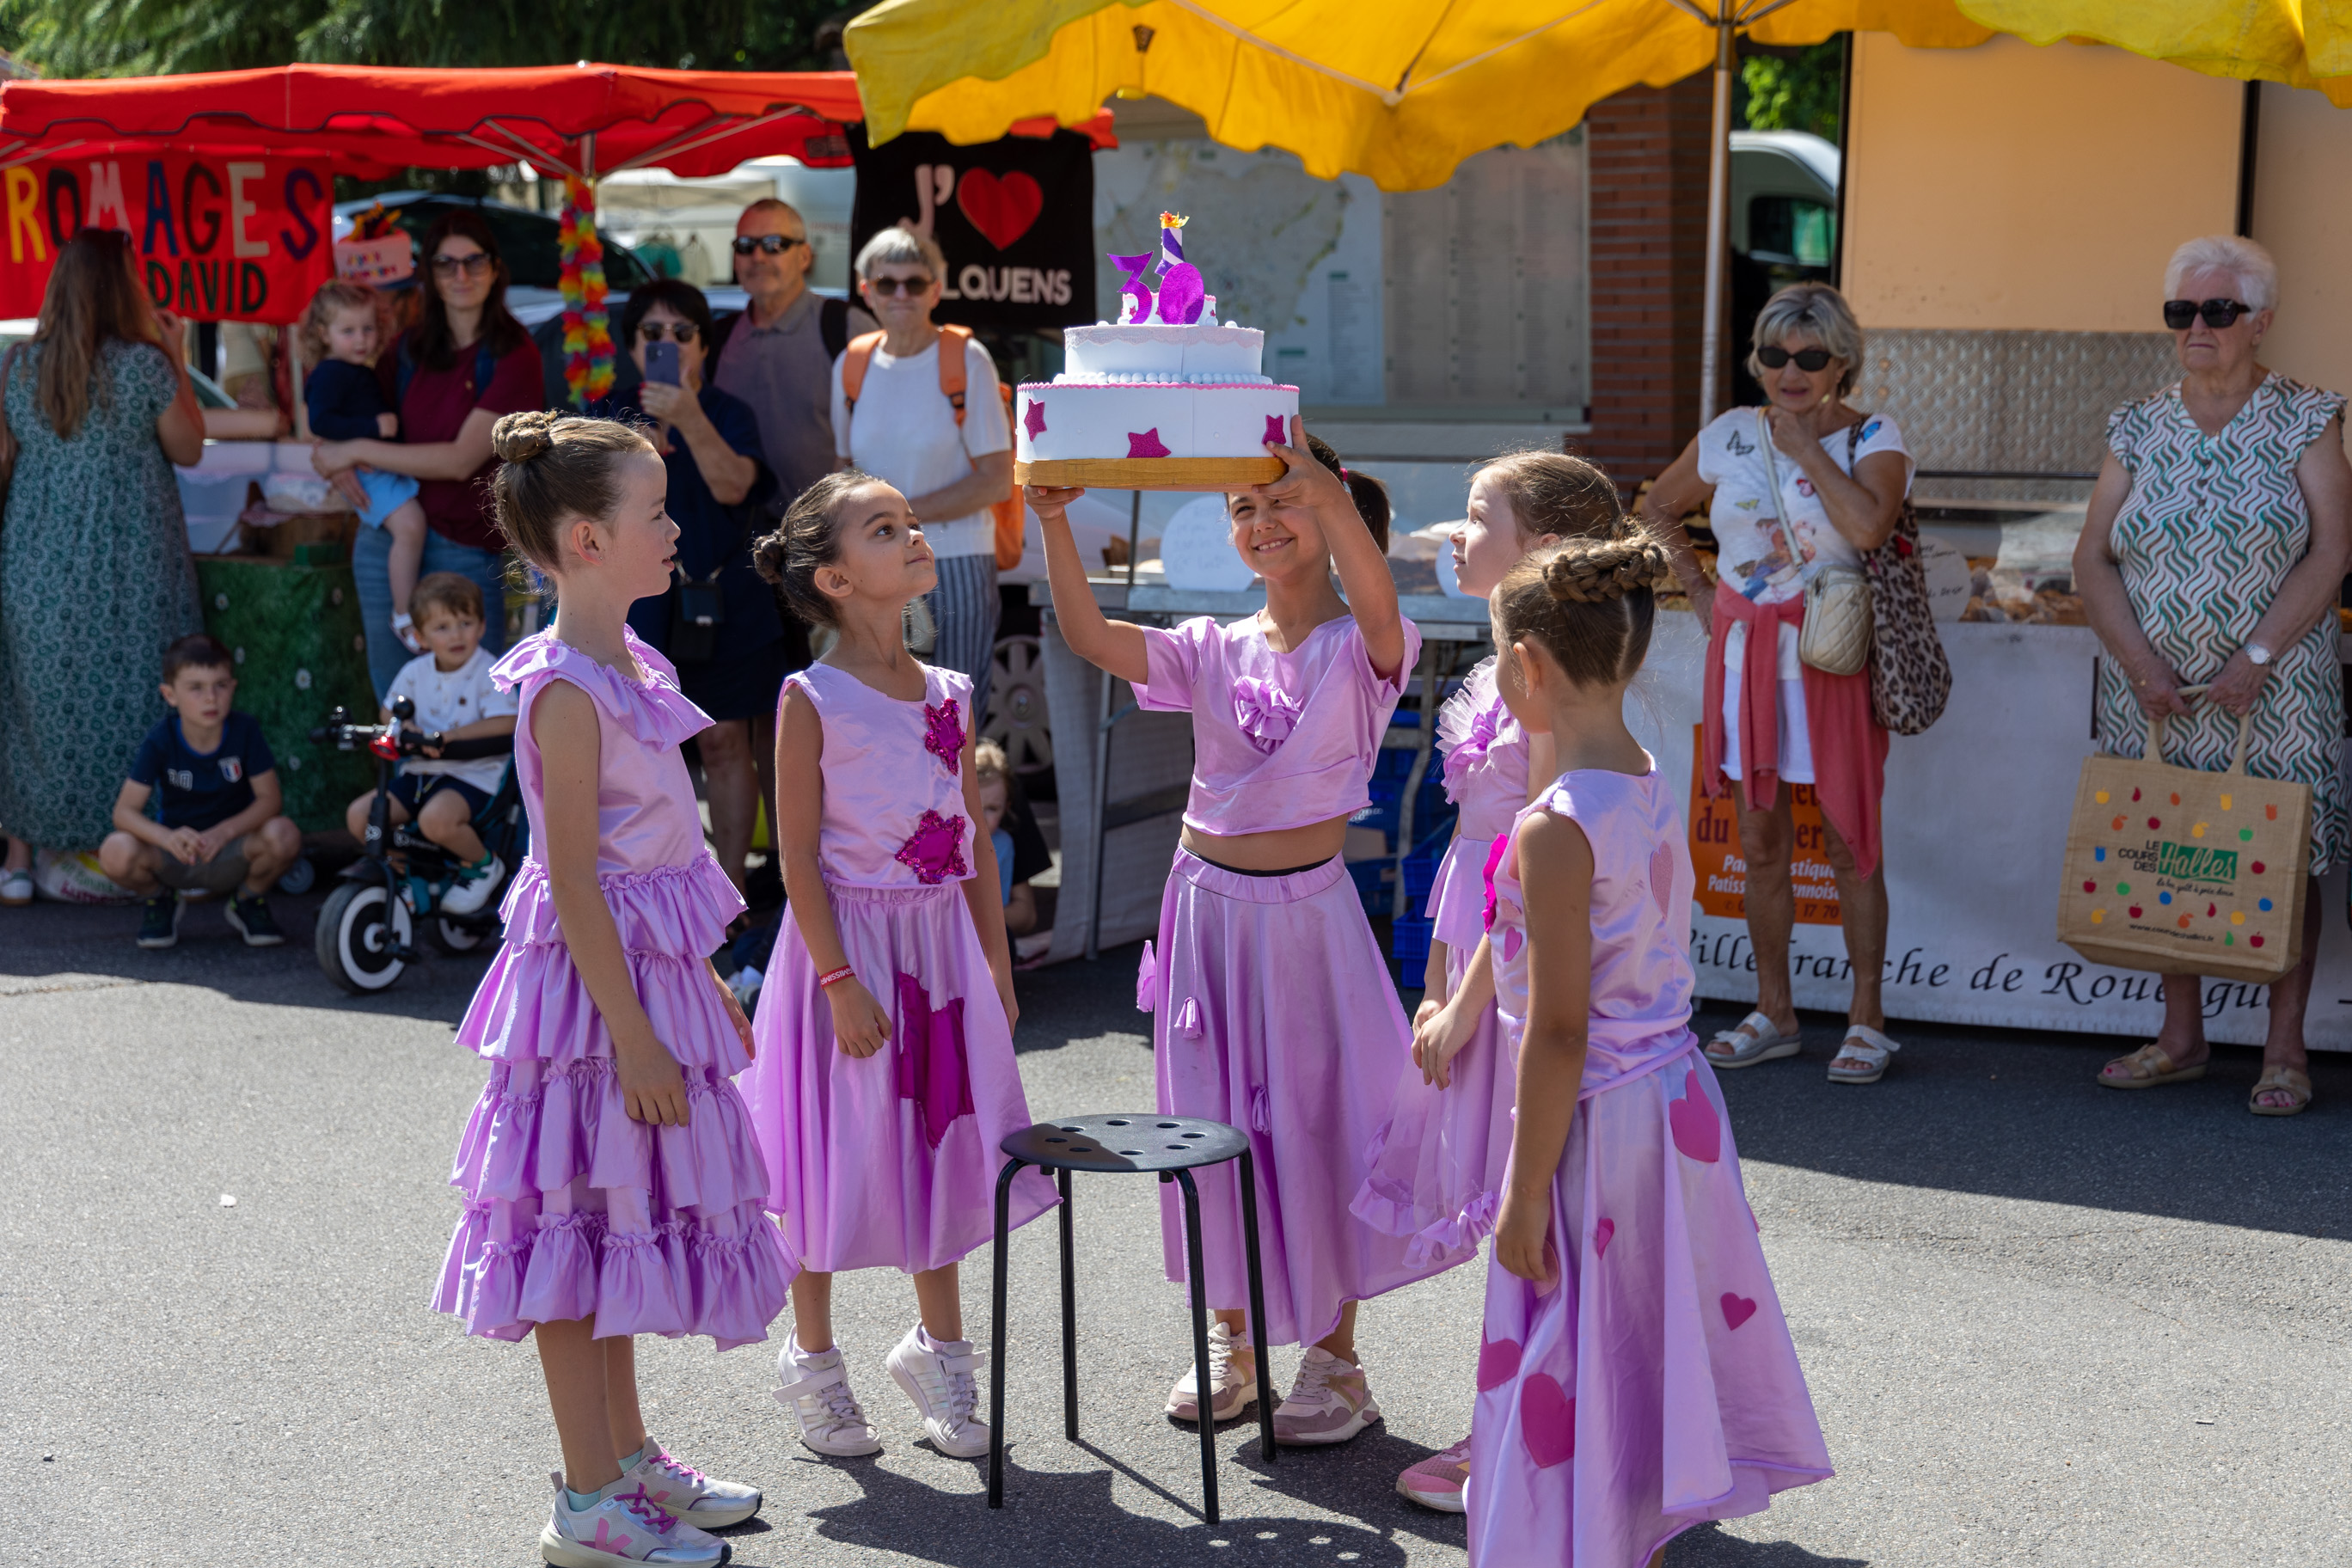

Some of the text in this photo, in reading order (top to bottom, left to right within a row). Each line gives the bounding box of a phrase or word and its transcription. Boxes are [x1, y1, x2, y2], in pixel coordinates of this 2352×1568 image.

[146, 260, 266, 313] DAVID
[940, 264, 1072, 305] LQUENS
[1106, 250, 1204, 325] 30
[1696, 805, 1729, 843] du
[2118, 848, 2159, 862] COURS
[2146, 840, 2159, 851] LE
[2159, 842, 2235, 881] Halles
[1707, 874, 1746, 895] Patiss
[2134, 861, 2158, 873] DES
[1822, 904, 1840, 920] 70
[1690, 928, 2269, 1019] illerache de Rouegu
